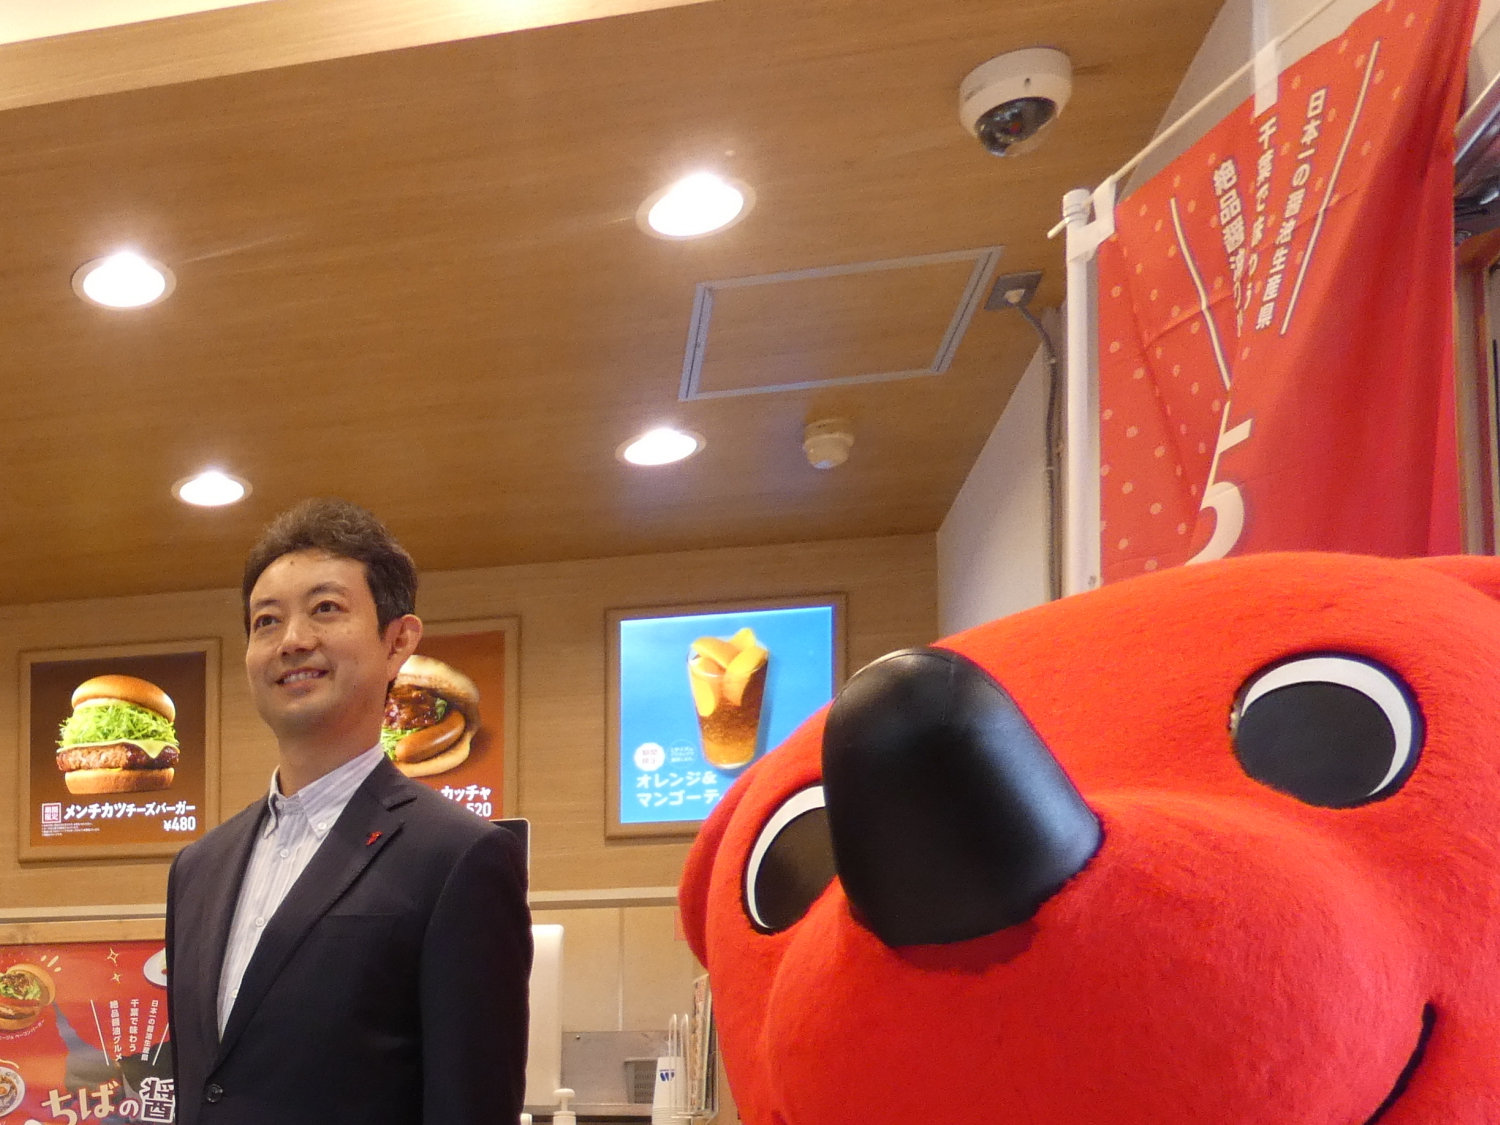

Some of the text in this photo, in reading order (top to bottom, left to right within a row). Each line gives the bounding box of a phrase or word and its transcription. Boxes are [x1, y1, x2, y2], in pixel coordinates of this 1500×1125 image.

[636, 771, 718, 789] オレンジ&
[439, 784, 492, 802] カッチャ
[636, 789, 722, 808] マンゴーテ
[63, 801, 196, 820] メンチカツチーズバーガー
[163, 816, 196, 832] ¥480
[129, 999, 139, 1052] 千葉で味わう
